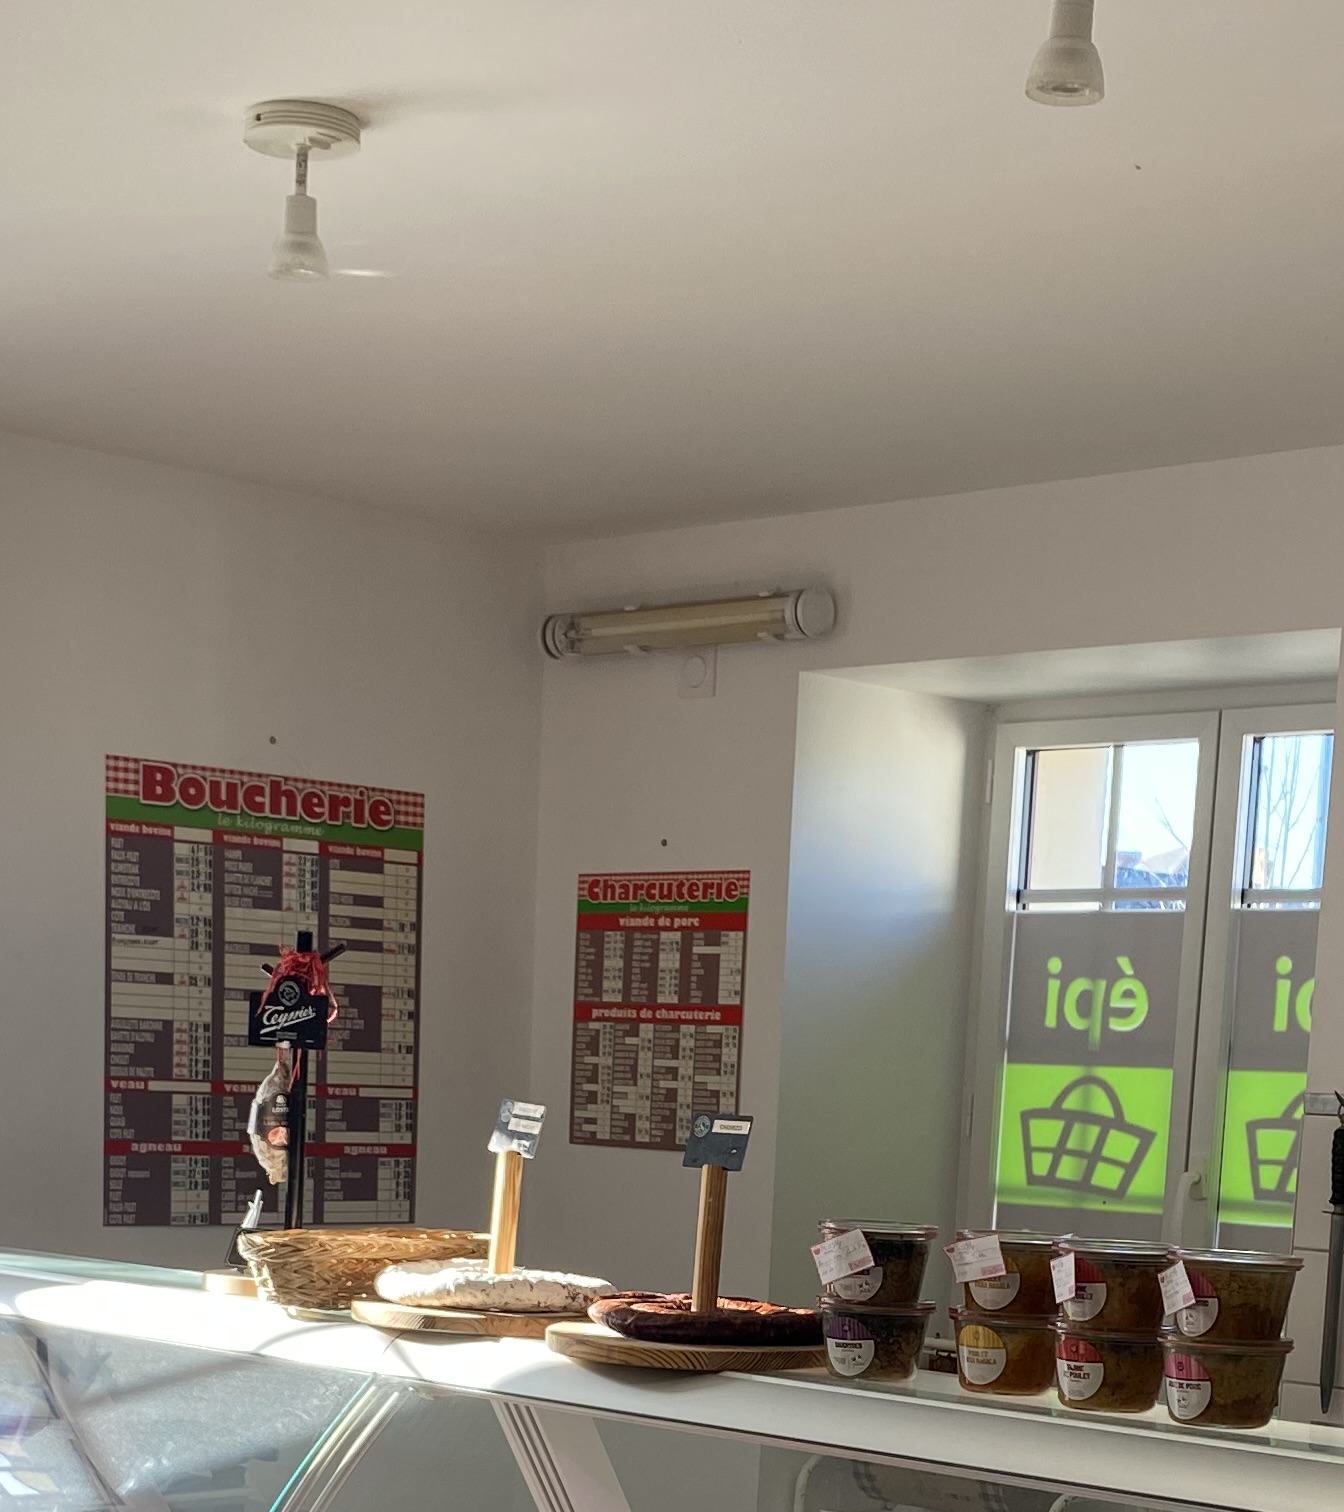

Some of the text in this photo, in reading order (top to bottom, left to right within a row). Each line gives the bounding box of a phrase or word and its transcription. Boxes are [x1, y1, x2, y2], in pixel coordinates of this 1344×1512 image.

[141, 762, 394, 829] Boucherie
[218, 814, 325, 838] le kilogramme
[587, 877, 740, 902] Charcuterie
[619, 916, 700, 928] viande de porc
[591, 1008, 721, 1021] produits de charcuterie
[111, 1080, 145, 1090] veau
[224, 1084, 256, 1093] veau
[327, 1087, 357, 1096] veau
[131, 1143, 182, 1154] agneau
[343, 1145, 388, 1156] agneau
